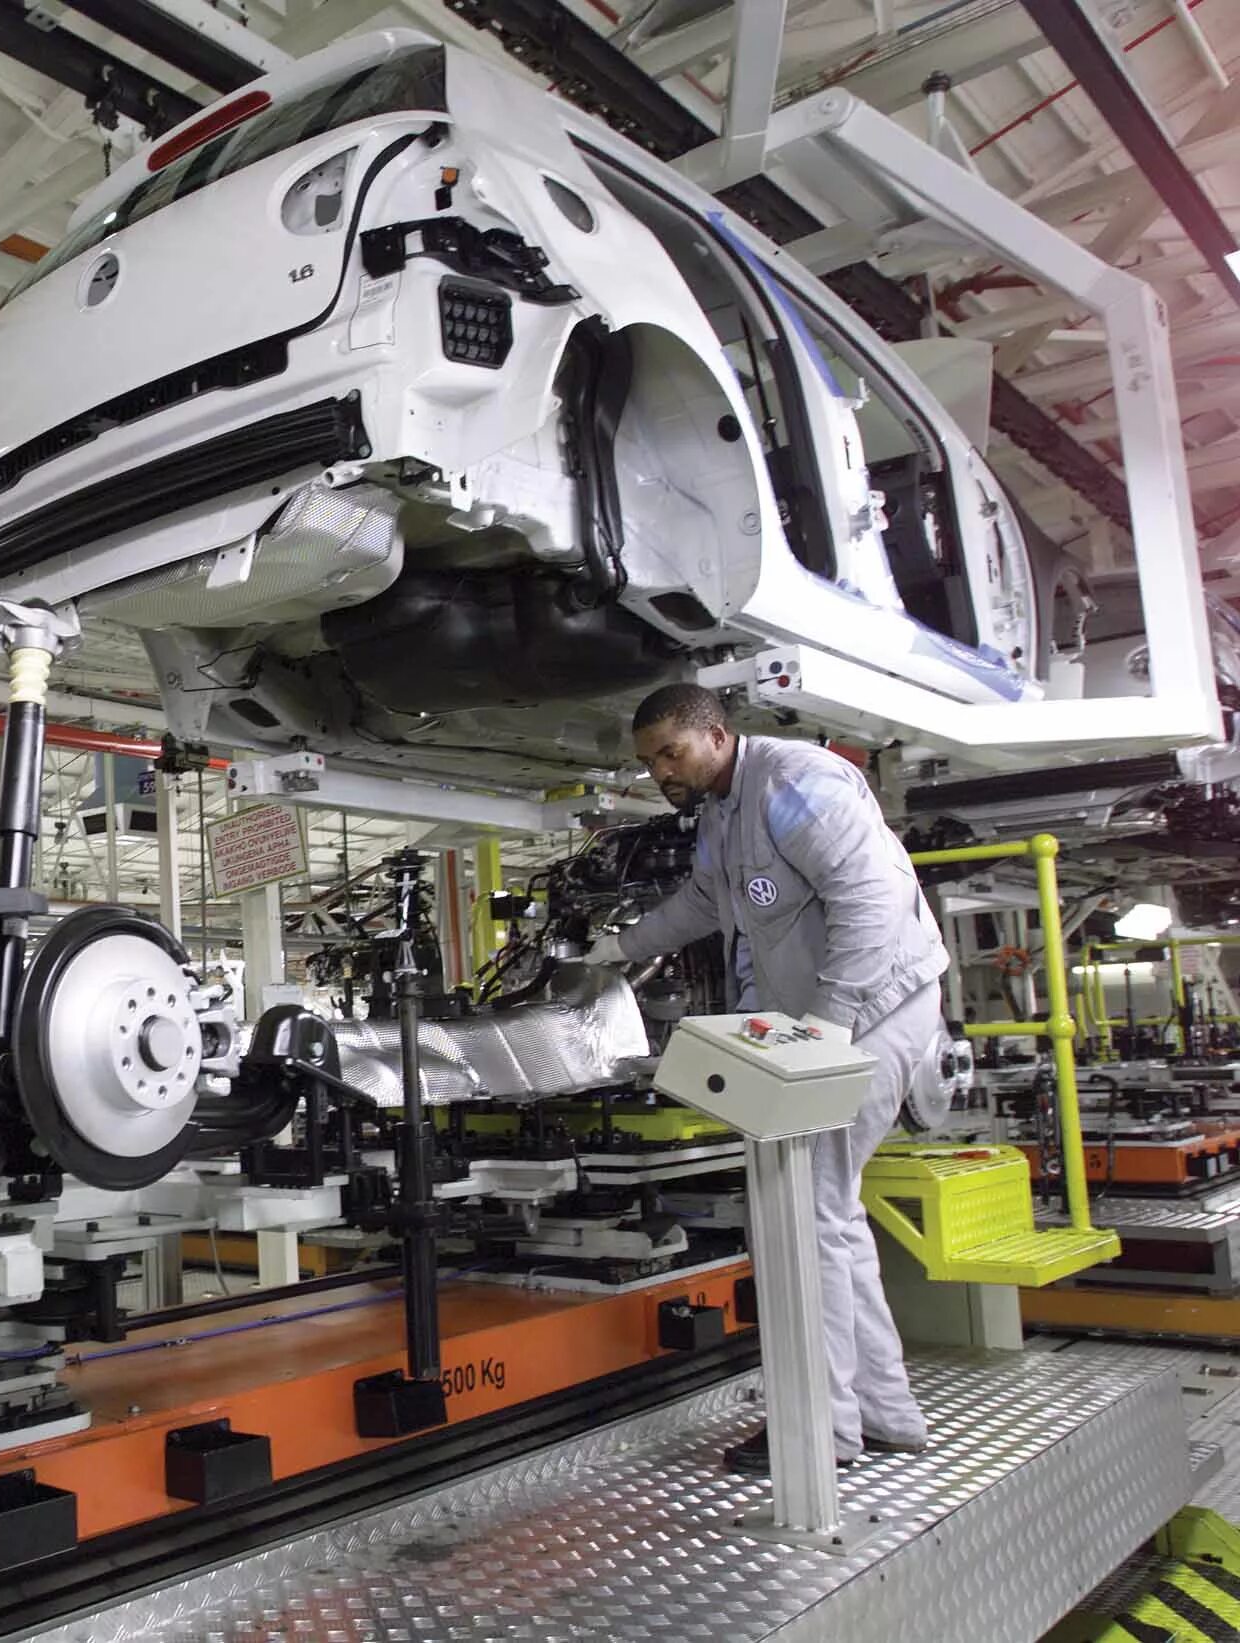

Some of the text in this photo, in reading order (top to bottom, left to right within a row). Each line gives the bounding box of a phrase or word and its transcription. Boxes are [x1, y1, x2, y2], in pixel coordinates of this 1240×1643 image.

[215, 814, 291, 846] ENTRY PROHIBITED
[220, 805, 282, 832] UNAUTHORISED
[257, 862, 297, 884] VERBODE
[481, 1356, 505, 1390] Kg
